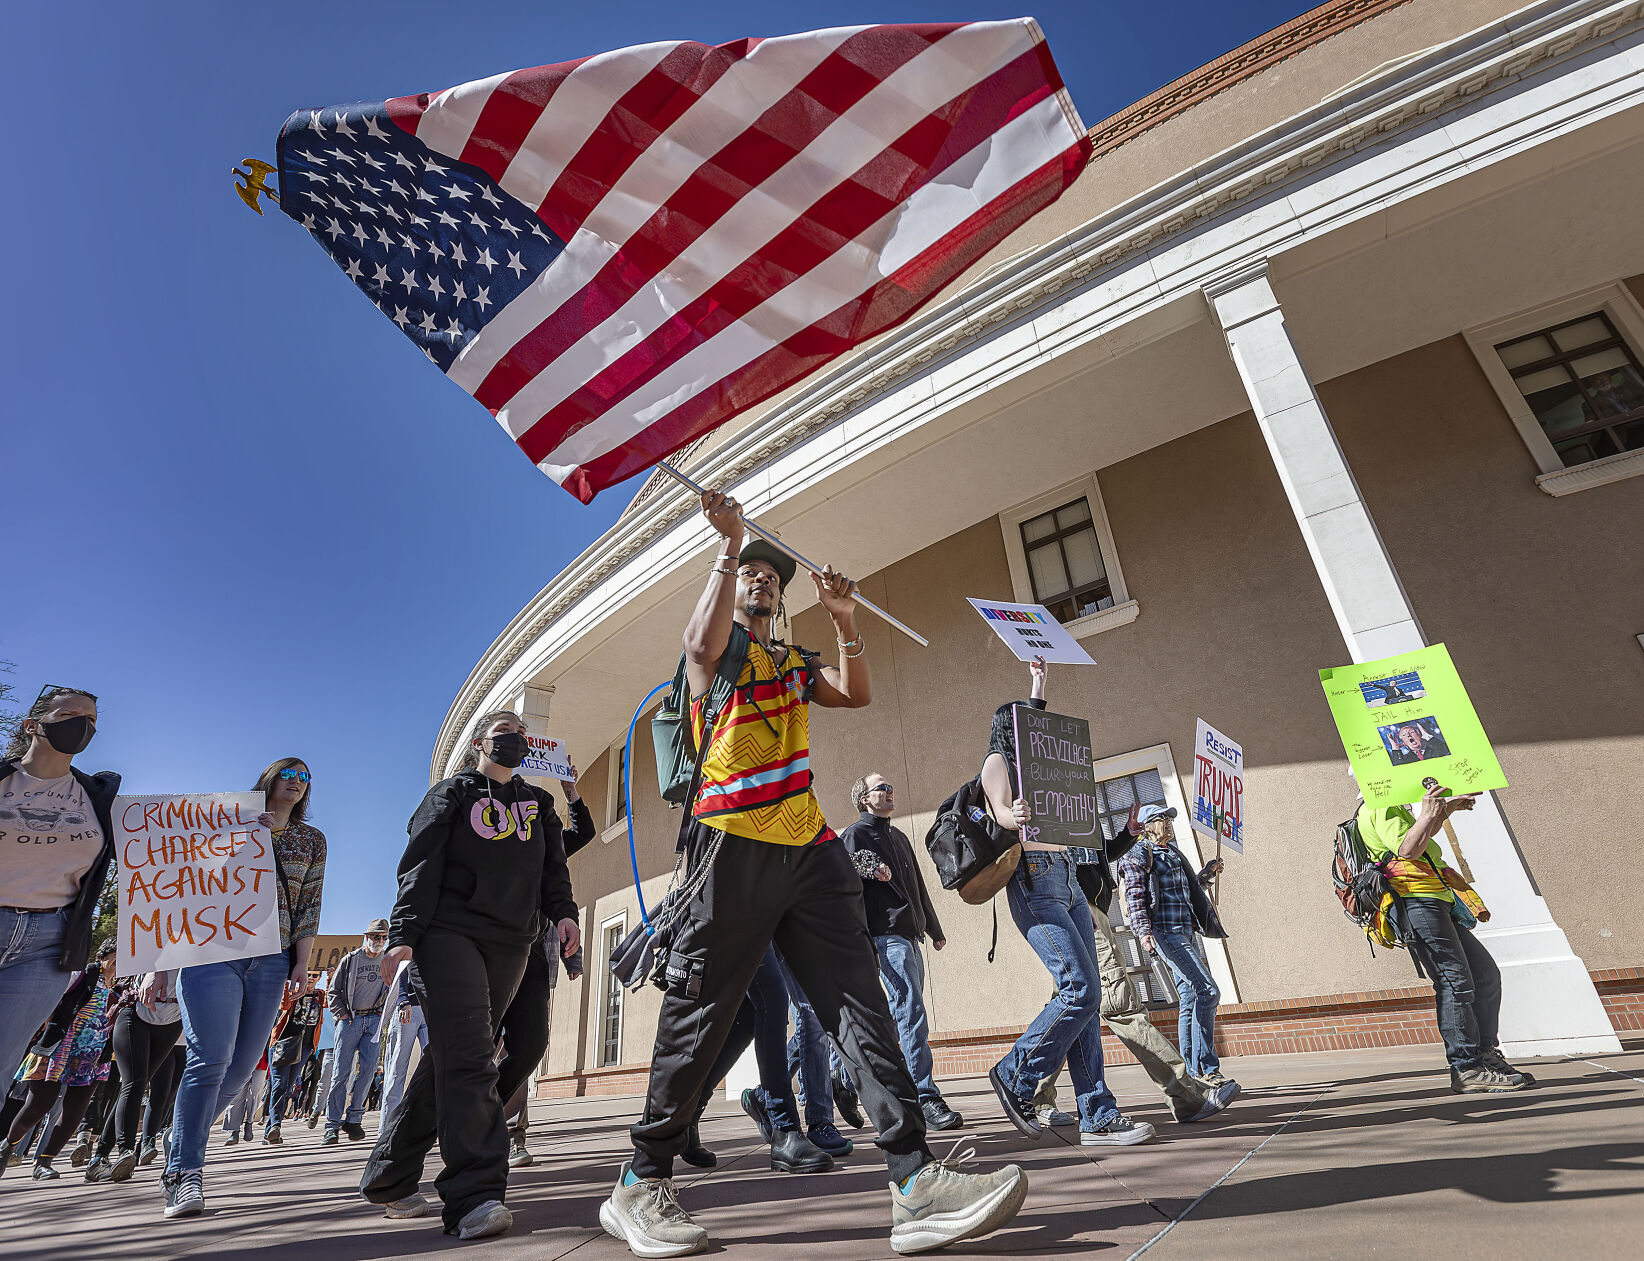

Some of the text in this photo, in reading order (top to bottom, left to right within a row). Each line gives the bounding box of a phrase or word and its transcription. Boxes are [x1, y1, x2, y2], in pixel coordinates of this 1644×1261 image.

[980, 607, 1047, 624] DIVERSITY
[1060, 720, 1080, 736] LET
[528, 749, 549, 761] KK
[1029, 731, 1092, 767] PRIVILAGE
[1206, 731, 1242, 764] RESIST
[521, 757, 553, 772] ACIST
[24, 790, 86, 806] COUNTRY
[1196, 754, 1243, 827] TRUMP
[122, 797, 256, 832] CRIMINAL
[1034, 790, 1096, 836] EMPATHY
[17, 835, 57, 845] OLD
[70, 828, 99, 841] MEN
[124, 829, 265, 870] CHARGES
[126, 865, 274, 905] AGAINST
[130, 904, 257, 957] MUSK
[357, 964, 375, 975] ENWAY
